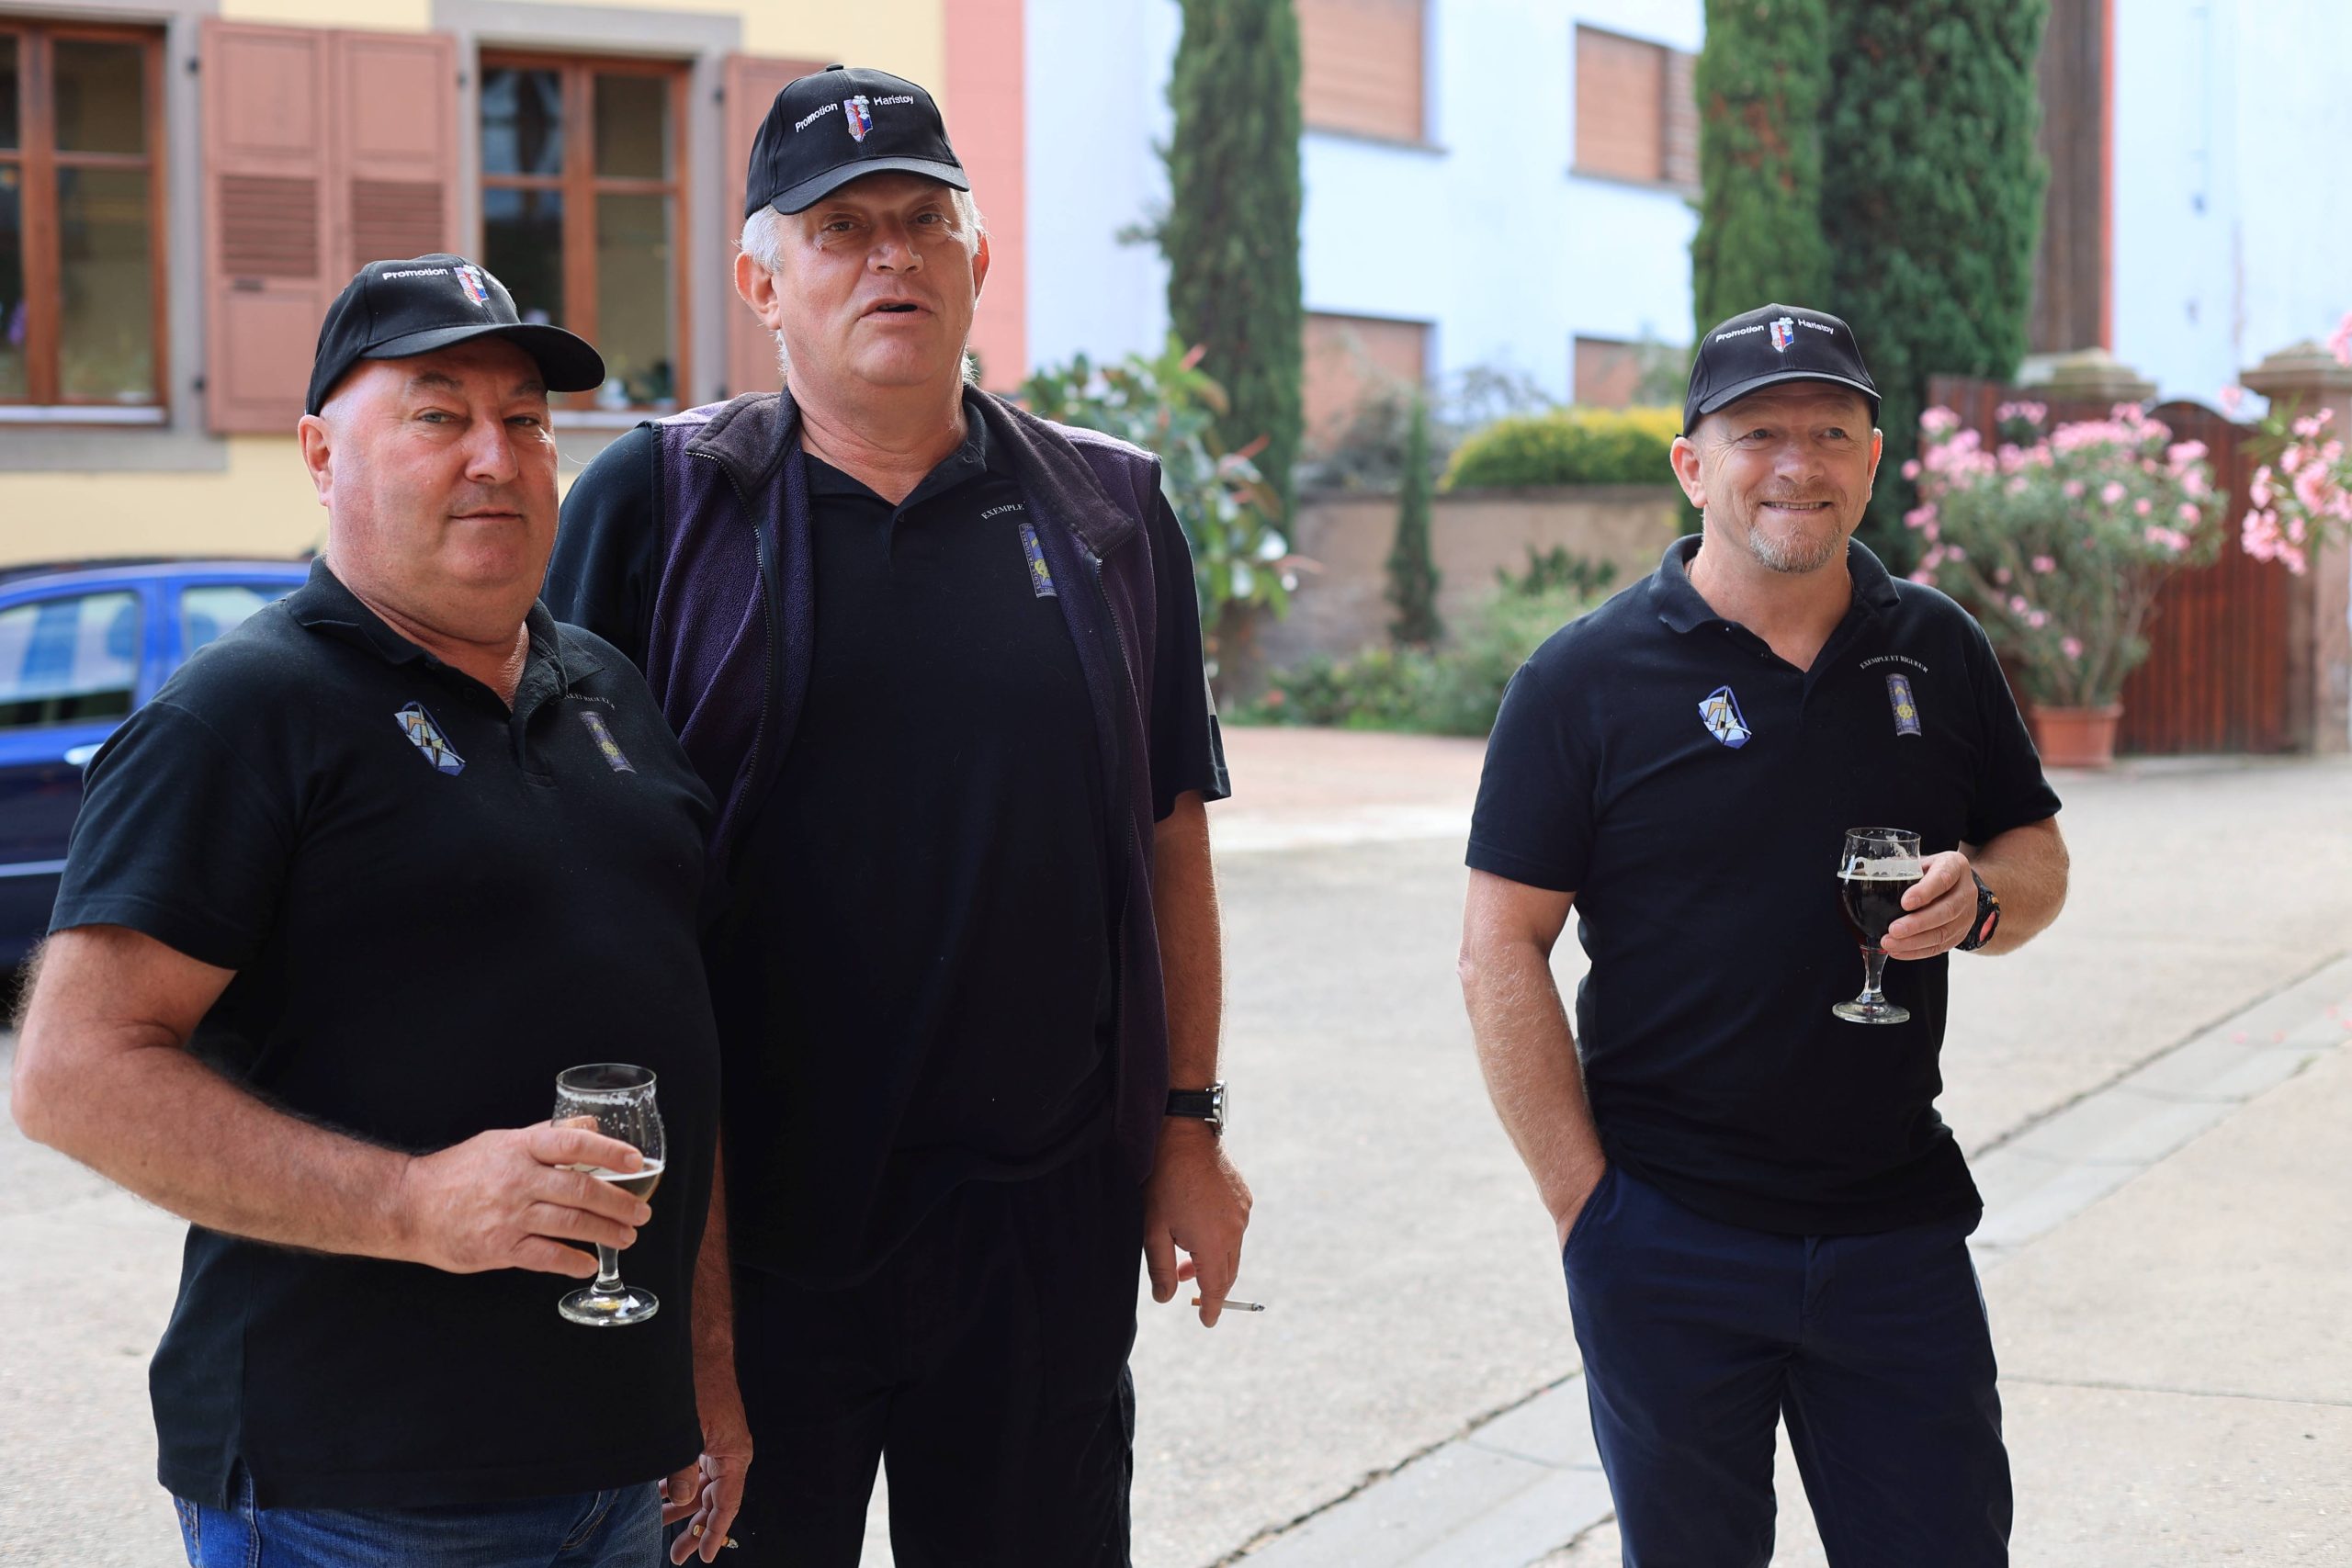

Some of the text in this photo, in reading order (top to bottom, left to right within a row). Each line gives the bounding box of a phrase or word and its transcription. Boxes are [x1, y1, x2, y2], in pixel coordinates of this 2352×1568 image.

[795, 95, 914, 132] Promotion Haristoy
[382, 267, 448, 280] Promotion
[1715, 324, 1764, 343] Promotion
